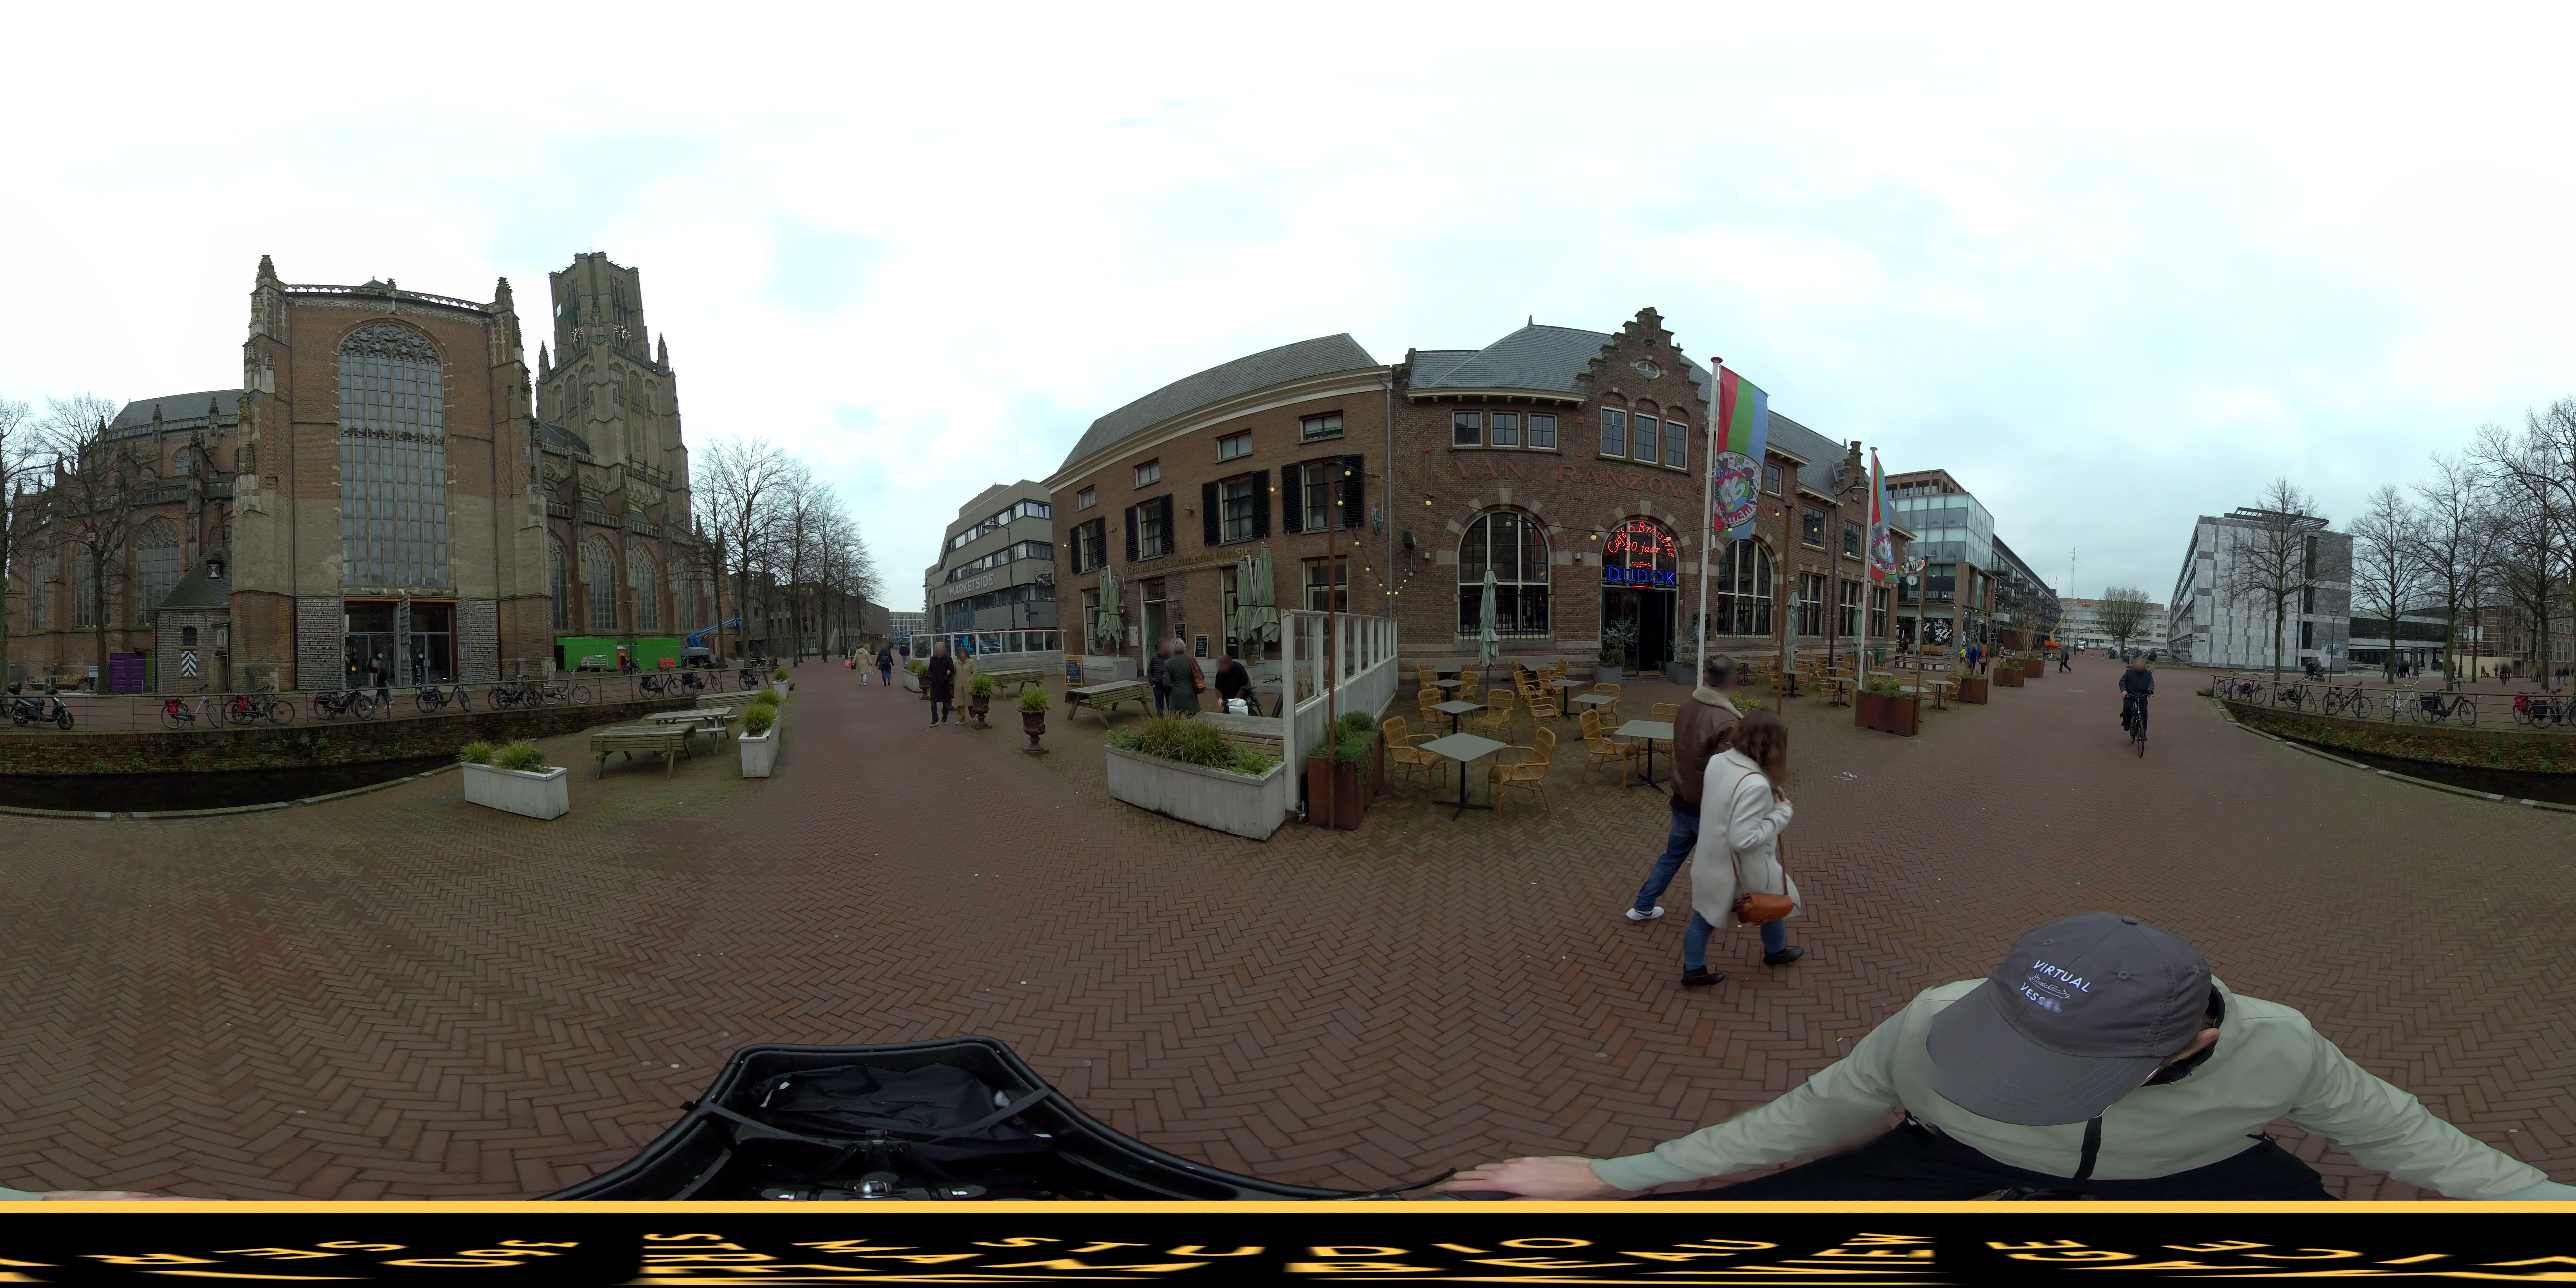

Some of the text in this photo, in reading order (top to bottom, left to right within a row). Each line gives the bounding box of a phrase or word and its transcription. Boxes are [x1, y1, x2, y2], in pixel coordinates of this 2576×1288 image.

[1454, 461, 1523, 479] VAN
[1608, 527, 1627, 553] Café
[1638, 522, 1675, 558] Brasserie
[1624, 541, 1660, 555] 20 jaar
[1127, 547, 1251, 575] Grand Café Arnhems Meisje
[949, 573, 994, 597] MARKETSIDE
[1608, 566, 1675, 585] DUDOK
[2033, 959, 2091, 993] VIRTUAL
